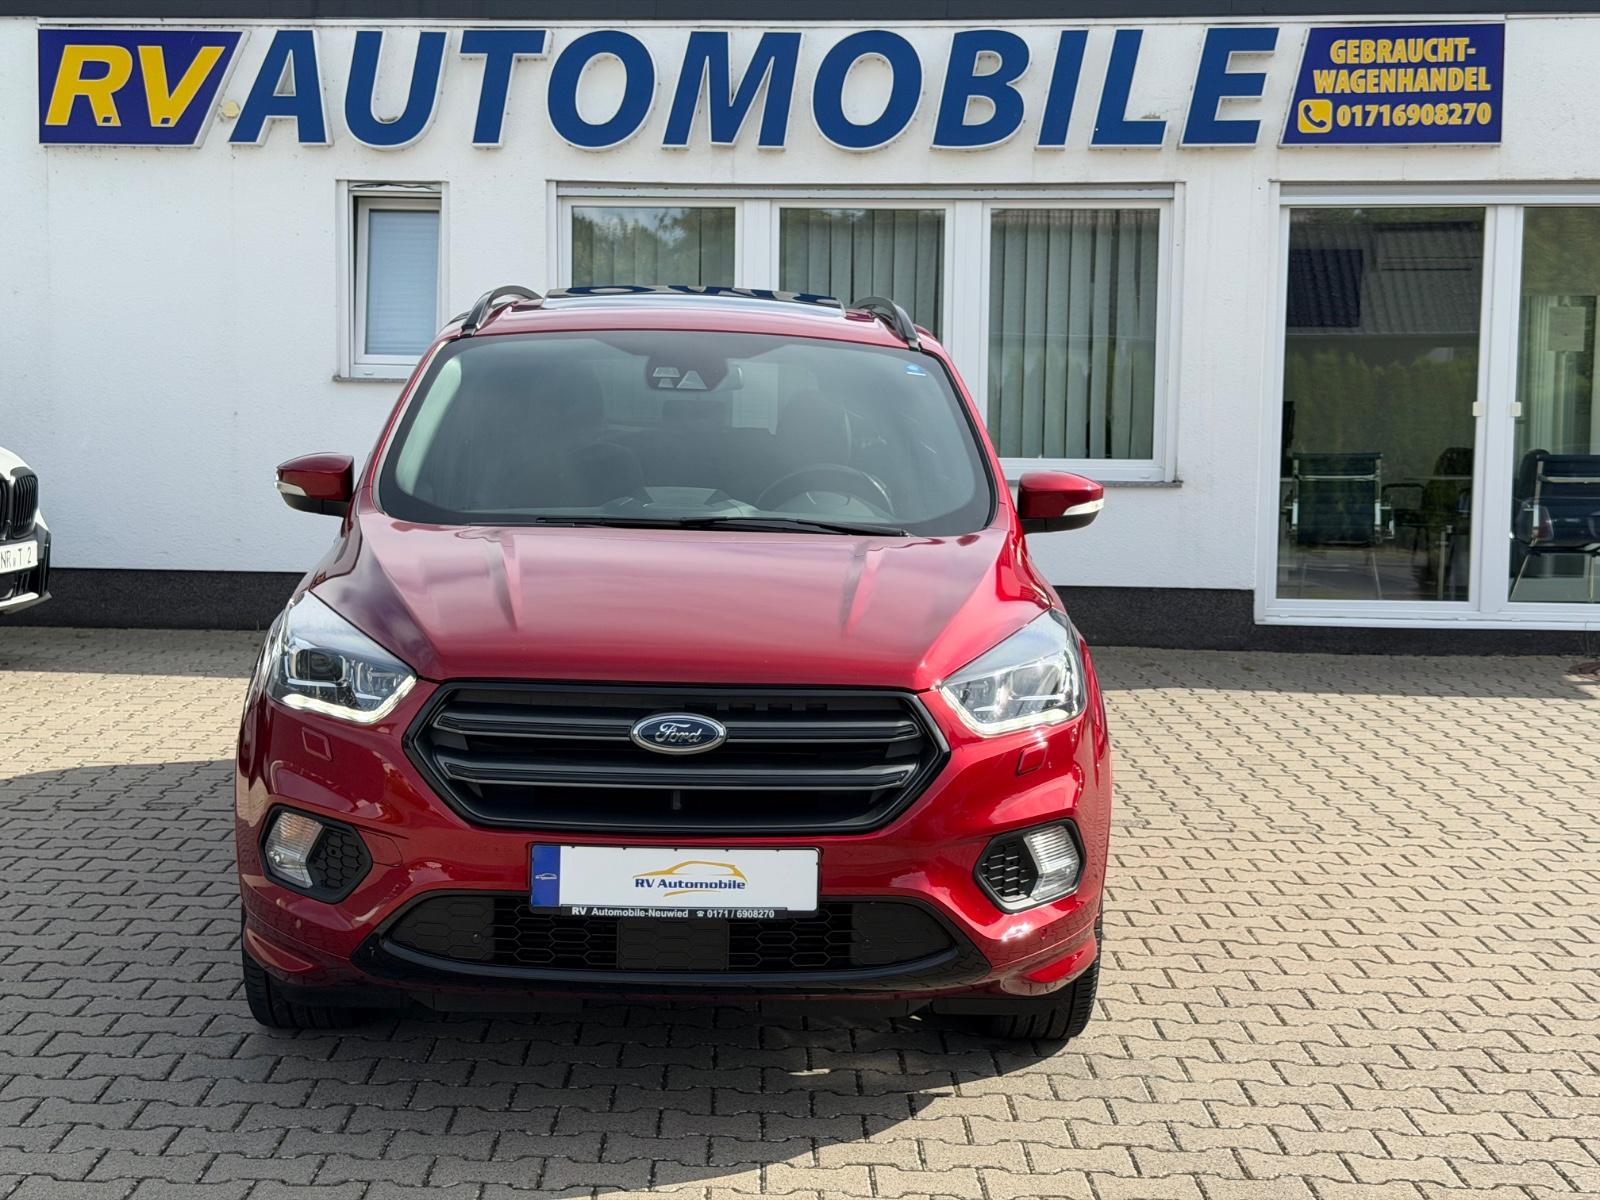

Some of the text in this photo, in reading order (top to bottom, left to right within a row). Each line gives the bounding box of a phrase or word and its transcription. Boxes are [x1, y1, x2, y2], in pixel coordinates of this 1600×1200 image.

[1329, 37, 1477, 64] GEBRAUCHT-
[44, 27, 1280, 150] RV AUTOMOBILE
[1312, 67, 1492, 94] WAGENHANDEL
[1336, 102, 1492, 127] 01716908270
[654, 722, 703, 743] Ford
[634, 878, 746, 890] RV Automobile
[571, 906, 587, 916] RV
[591, 907, 689, 918] Automobile-Neuwied
[706, 908, 729, 918] 0171
[736, 908, 775, 918] 6908270
